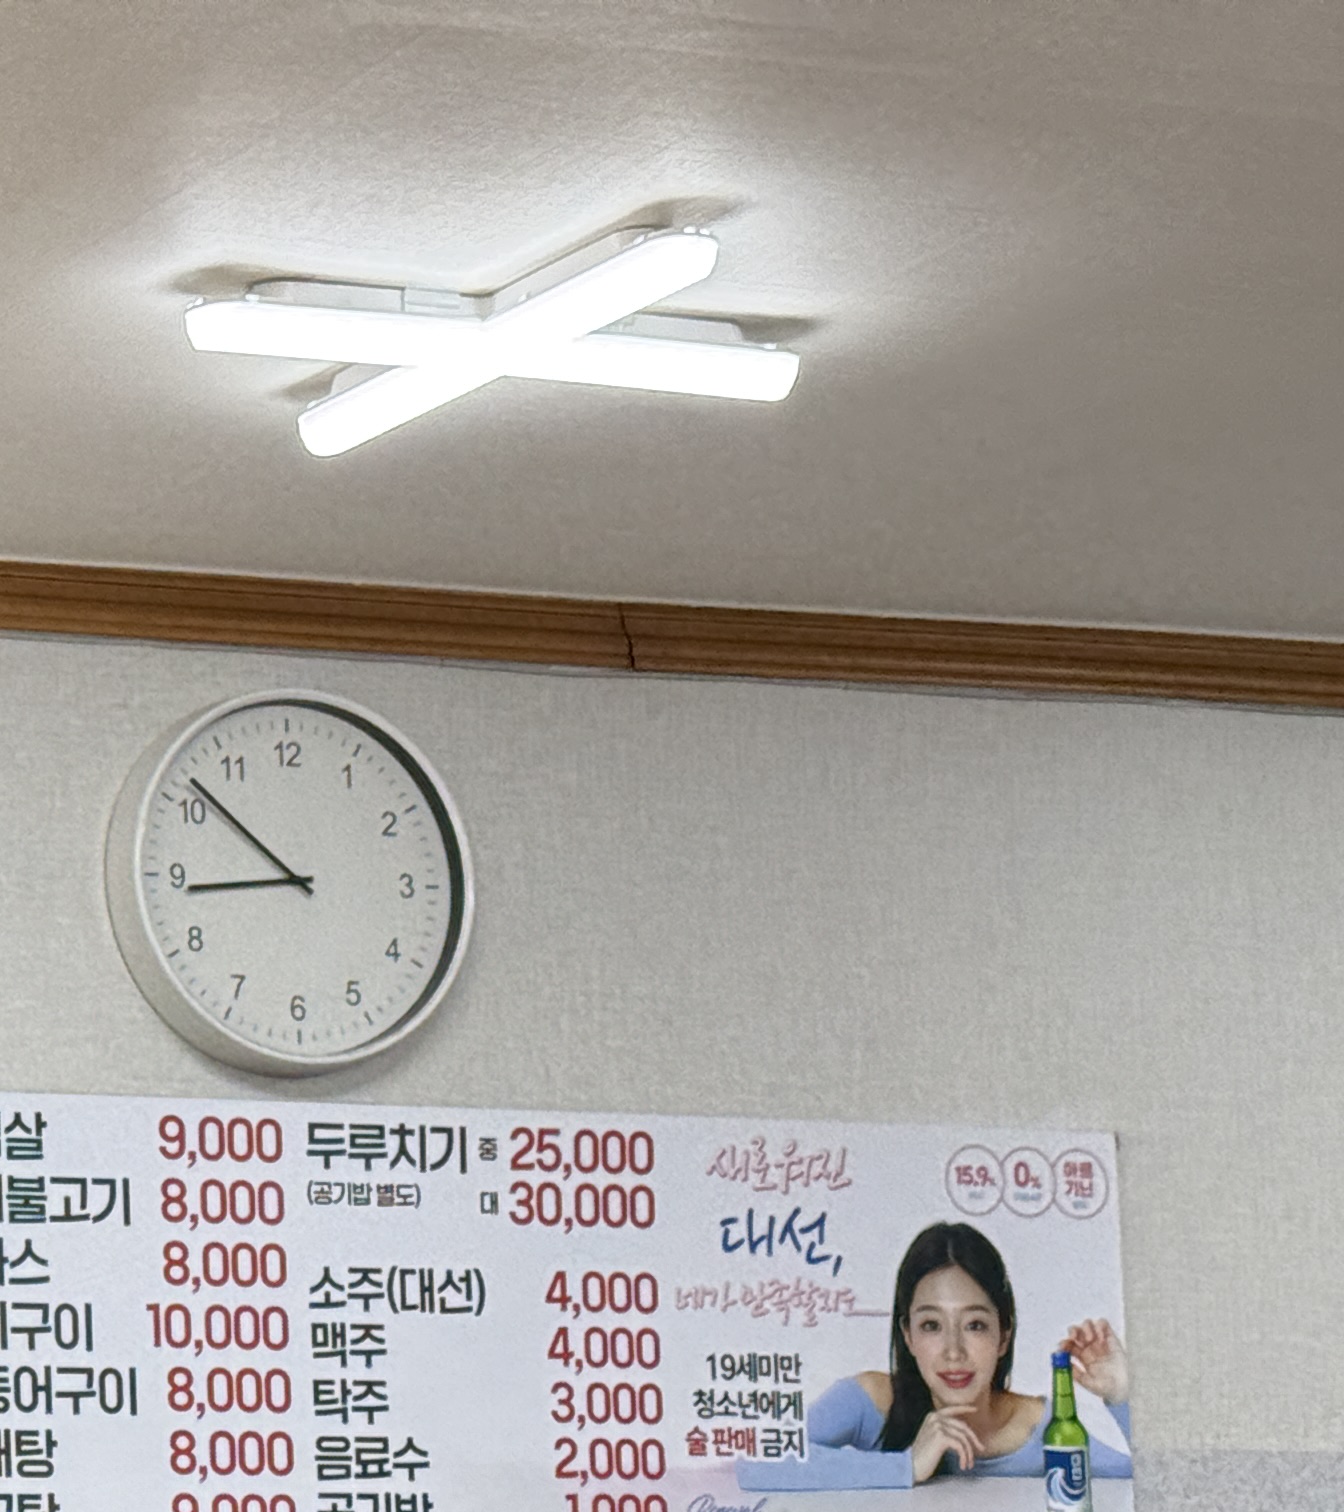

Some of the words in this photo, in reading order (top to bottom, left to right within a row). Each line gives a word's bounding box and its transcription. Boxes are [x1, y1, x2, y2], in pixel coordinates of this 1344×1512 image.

[220, 755, 245, 782] 11
[273, 740, 302, 768] 12
[341, 763, 353, 789] 1
[178, 797, 205, 825] 10
[381, 810, 398, 838] 2
[169, 862, 186, 890] 9
[398, 872, 416, 900] 3
[187, 925, 204, 953] 8
[384, 937, 402, 963] 4
[230, 973, 247, 1001] 7
[345, 979, 362, 1007] 5
[289, 994, 307, 1022] 6
[158, 1114, 283, 1169] 9,000
[306, 1122, 468, 1175] 두루치기
[509, 1126, 655, 1181] 25,000
[1013, 1160, 1042, 1189] 0%
[160, 1177, 285, 1232] 8,000
[479, 1191, 500, 1216] 대
[508, 1180, 656, 1235] 30,000
[162, 1239, 288, 1294] 8,000
[308, 1265, 486, 1317] 소주(대선)
[544, 1270, 659, 1320] 4,000
[145, 1302, 290, 1358] 10,000
[310, 1321, 388, 1369] 맥주
[547, 1326, 661, 1376] 4,000
[705, 1352, 803, 1385] 19세미만
[167, 1366, 292, 1420] 8,000
[312, 1378, 390, 1426] 탁주
[550, 1381, 664, 1431] 3,000
[692, 1388, 804, 1422] 청소년에게
[169, 1429, 295, 1483] 8,000
[683, 1424, 710, 1460] 술
[711, 1424, 756, 1460] 판매
[759, 1425, 806, 1460] 금지
[314, 1435, 431, 1482] 음료수
[554, 1436, 667, 1488] 2,000
